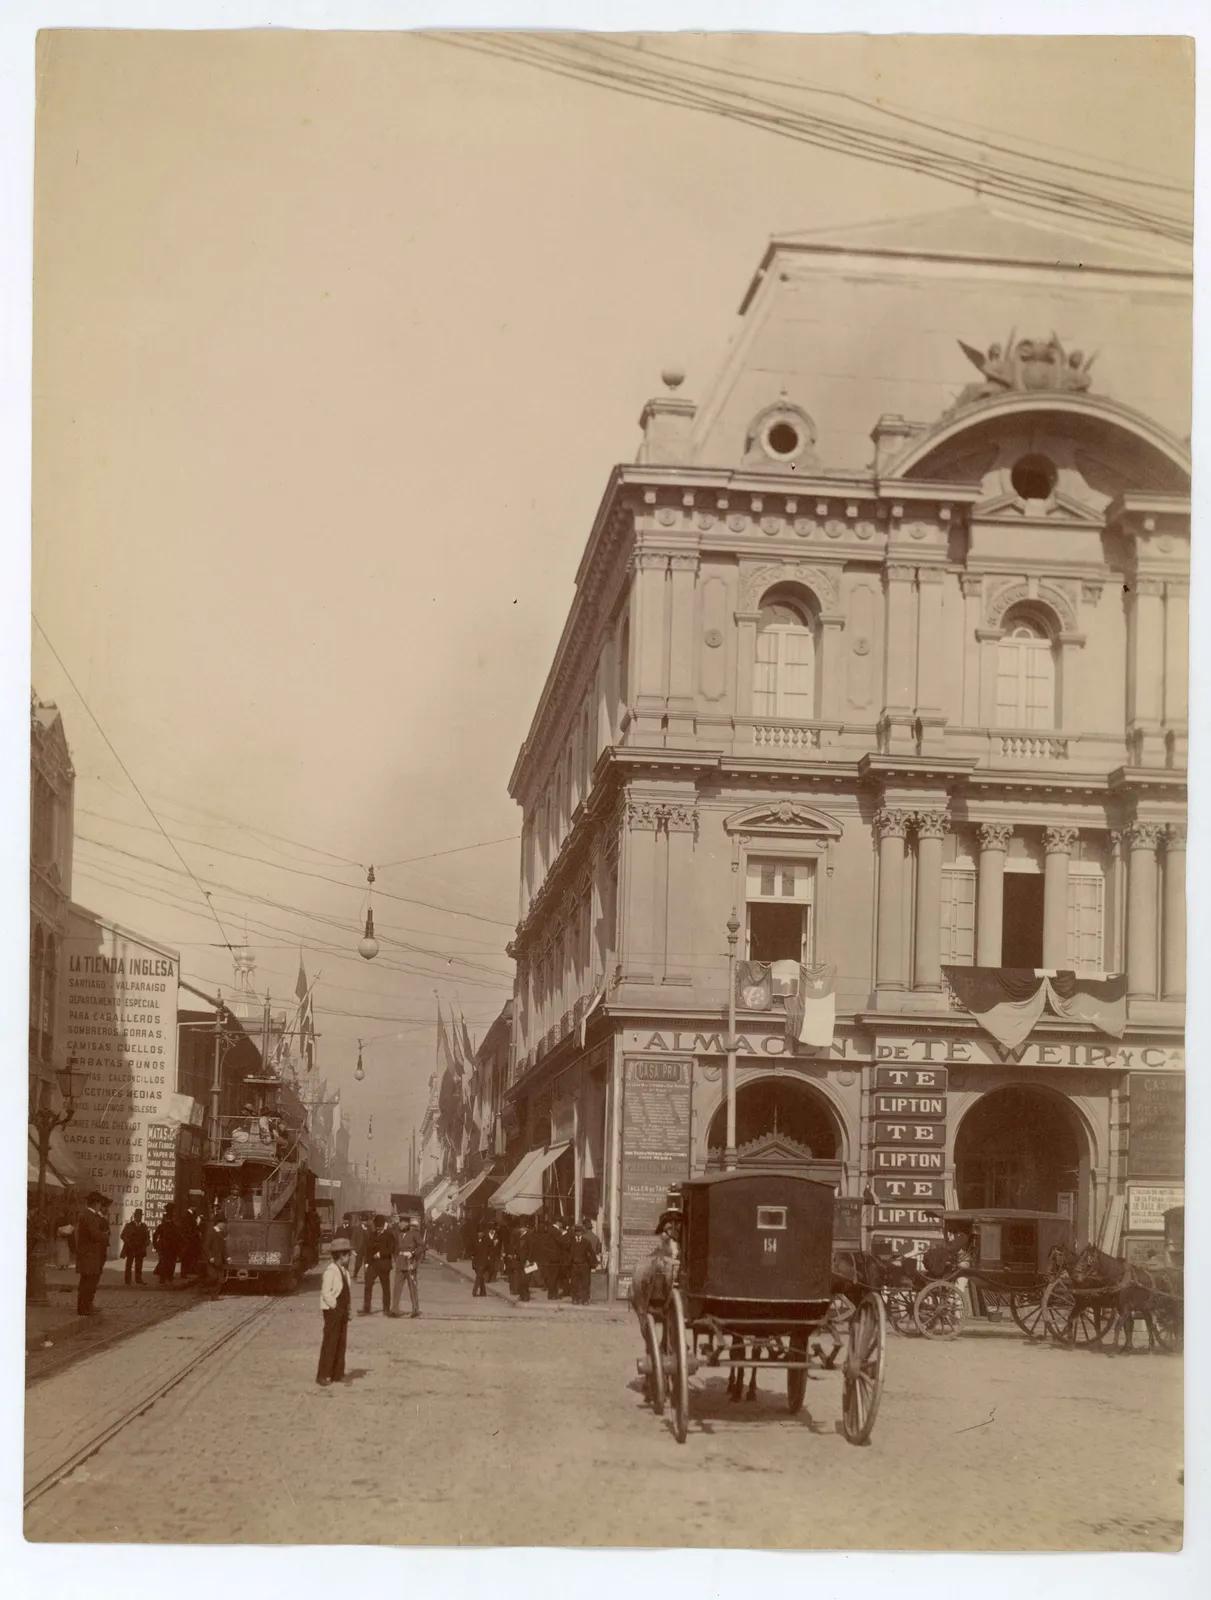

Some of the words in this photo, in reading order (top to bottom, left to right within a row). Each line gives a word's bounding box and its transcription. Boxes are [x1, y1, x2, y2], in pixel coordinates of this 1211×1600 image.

[69, 955, 80, 973] LA
[84, 956, 124, 975] TIENDA
[129, 958, 174, 977] INGLESA
[116, 981, 166, 992] VALPARAISO
[125, 998, 160, 1009] ESPECIAL
[69, 1010, 89, 1021] PARA
[67, 1025, 118, 1037] SOMBREROS
[67, 1041, 111, 1051] CAMISAS
[876, 1045, 909, 1060] DE
[989, 1041, 1116, 1068] WEIR
[1118, 1050, 1134, 1067] Y
[639, 1062, 659, 1080] CASA
[889, 1071, 935, 1086] TE
[126, 1089, 162, 1100] MEDIAS
[880, 1098, 942, 1113] LIPTON
[887, 1125, 934, 1140] TE
[63, 1133, 96, 1146] CAPAS
[99, 1136, 111, 1146] DE
[115, 1137, 143, 1148] VIAJE
[879, 1153, 941, 1167] LIPTON
[886, 1181, 933, 1196] TE
